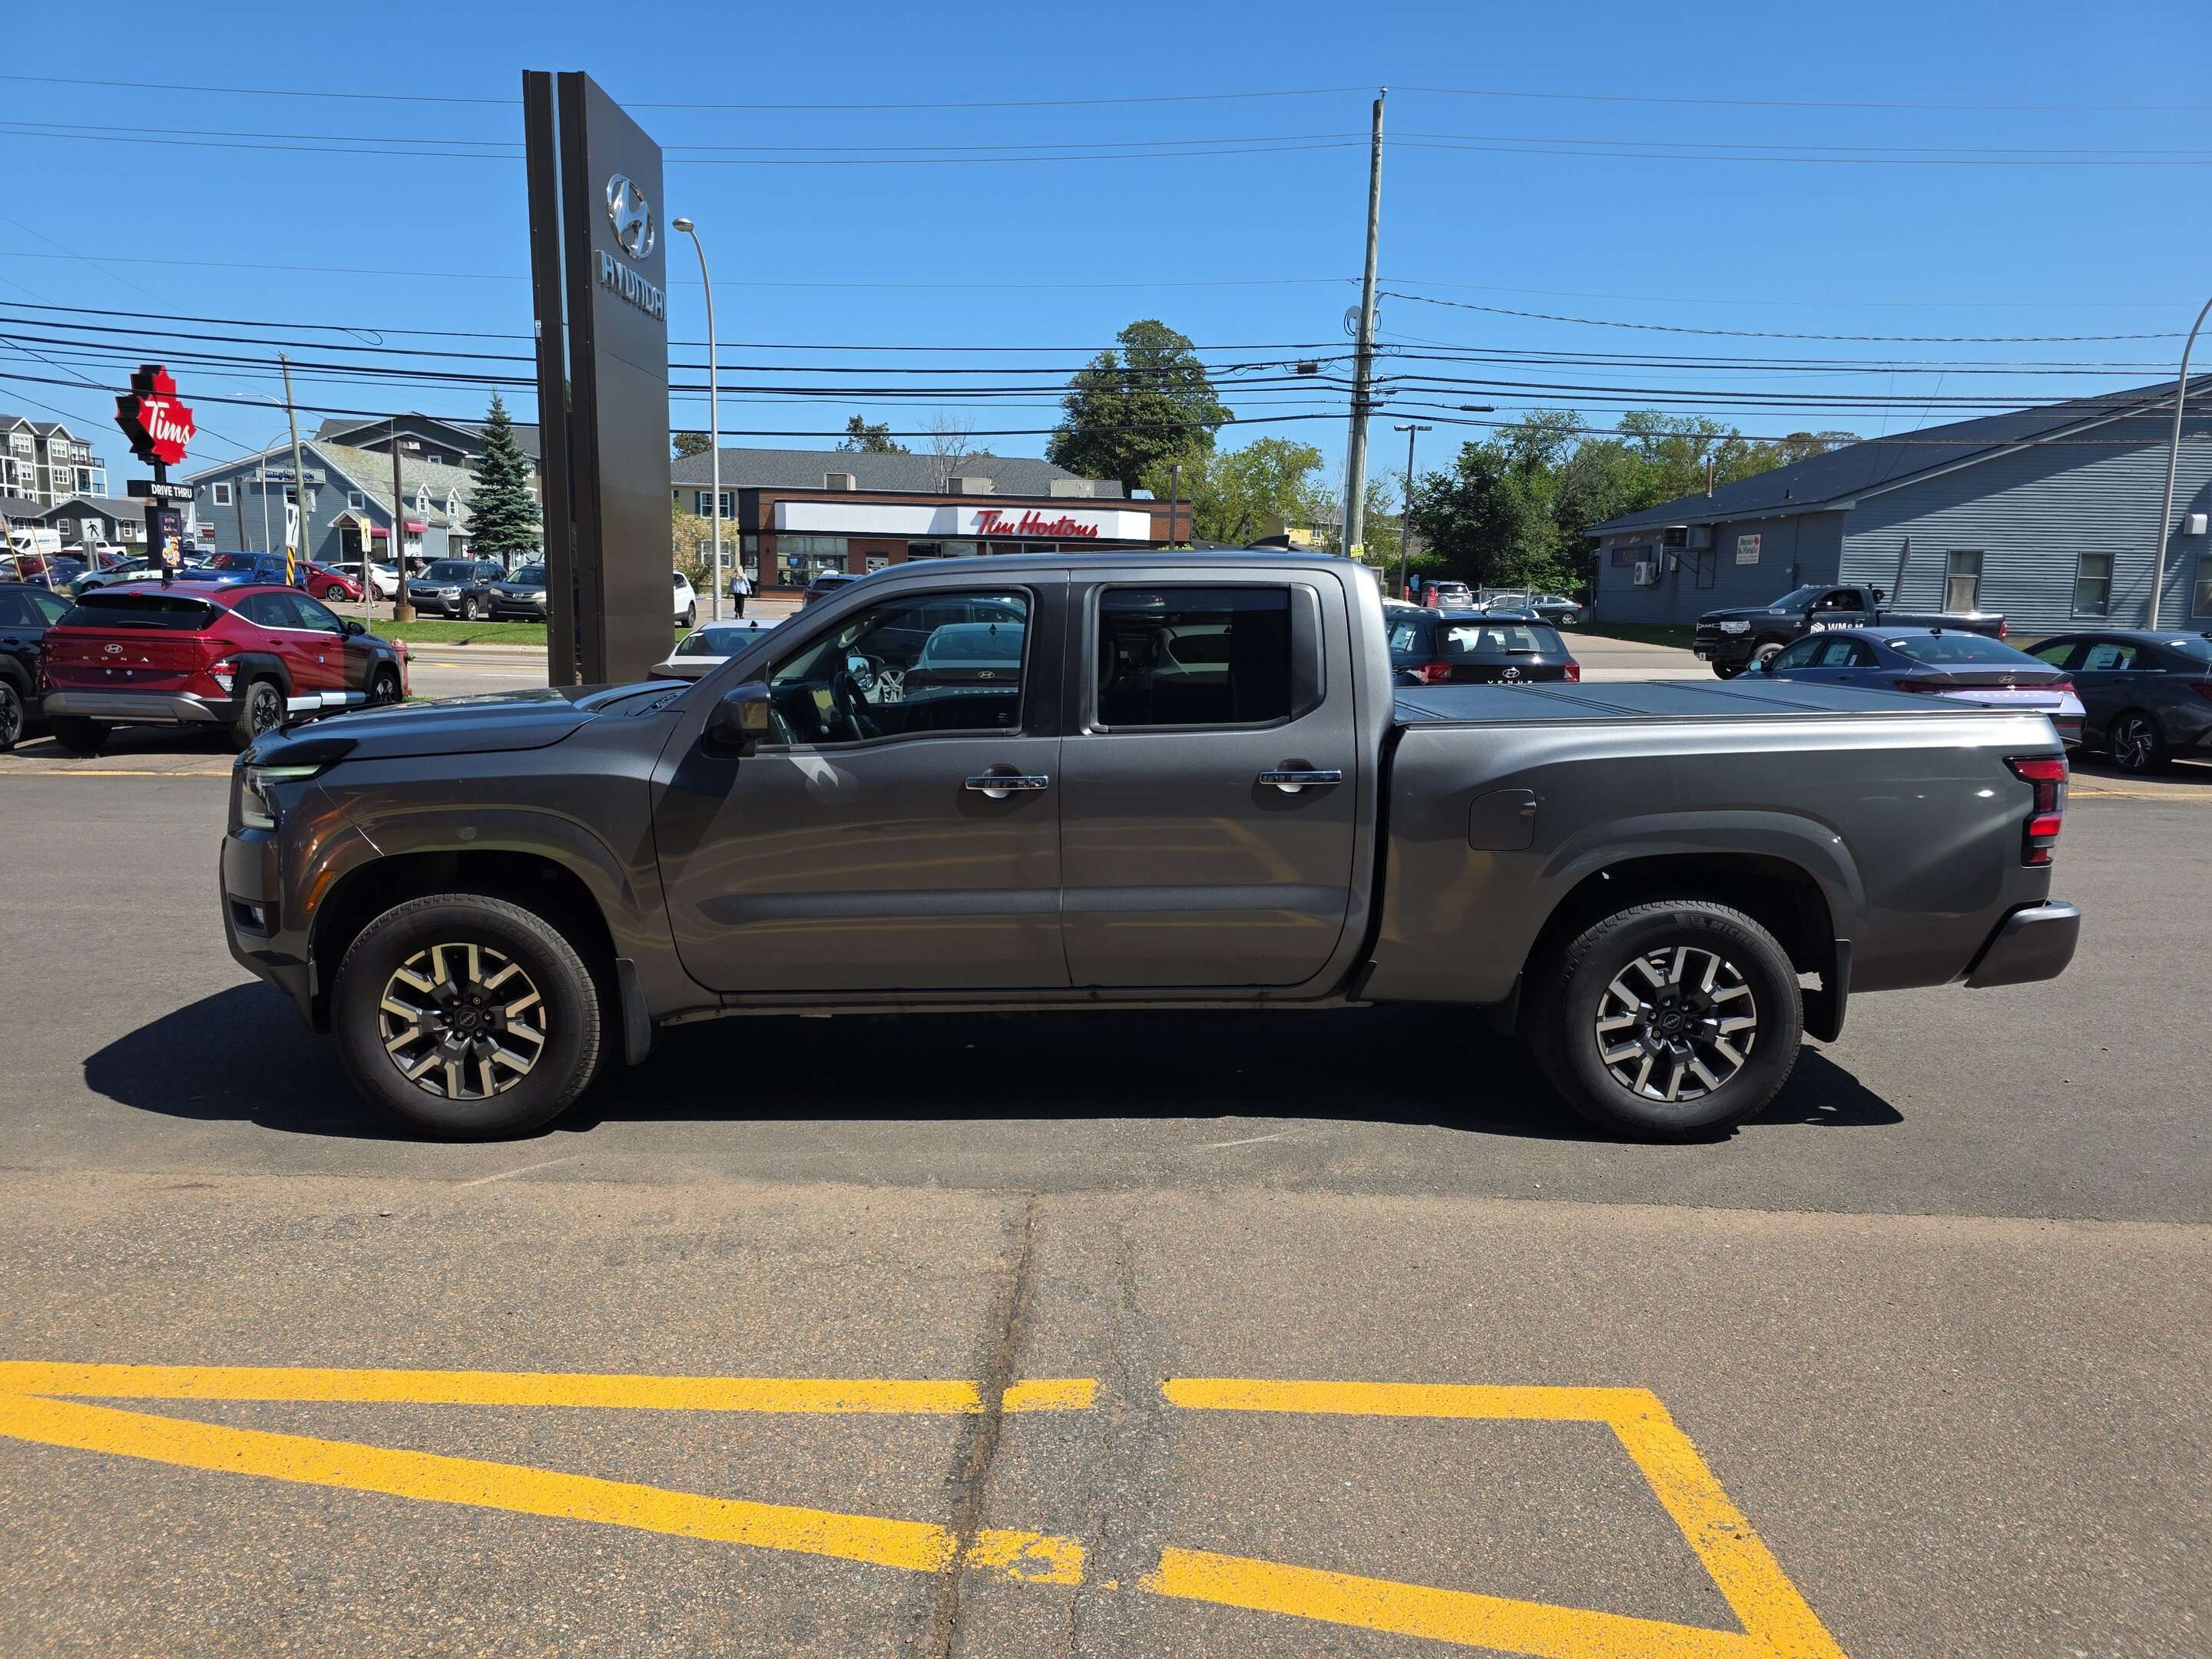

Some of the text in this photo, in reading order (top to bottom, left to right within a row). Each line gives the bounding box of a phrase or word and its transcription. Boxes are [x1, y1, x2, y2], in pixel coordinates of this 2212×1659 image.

[595, 250, 667, 321] HYUNDAI
[144, 400, 191, 445] Tims
[151, 483, 193, 498] DRIVE THRU
[977, 509, 1099, 538] Tim Hortons
